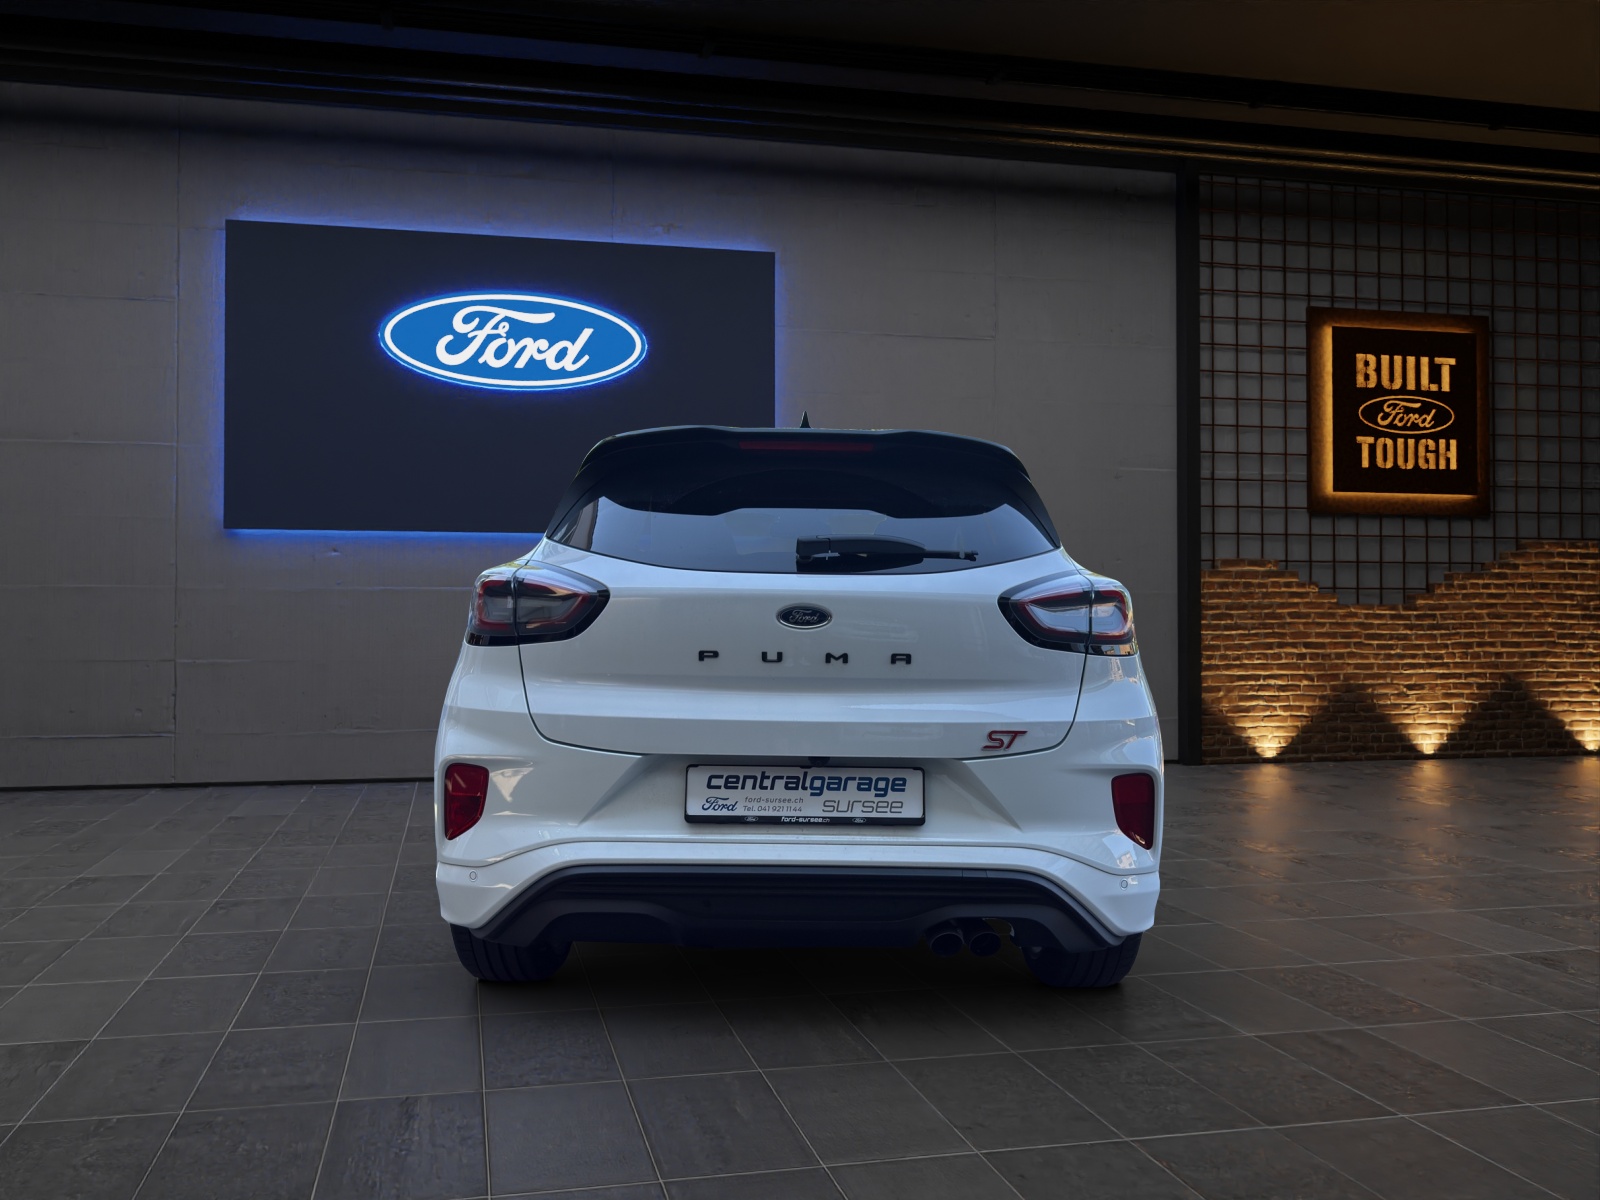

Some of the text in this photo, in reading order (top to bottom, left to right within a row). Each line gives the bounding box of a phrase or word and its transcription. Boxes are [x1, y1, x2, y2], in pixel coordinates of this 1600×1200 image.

[436, 305, 594, 372] Ford
[1355, 353, 1456, 392] BUILT
[1377, 400, 1437, 428] Ford
[1355, 436, 1457, 470] TOUGH
[788, 609, 820, 623] Ford
[698, 650, 912, 665] PUMA
[981, 730, 1028, 751] ST
[706, 770, 907, 797] centralgarage
[701, 796, 739, 812] Ford
[744, 796, 804, 804] ford-sursee.ch
[822, 800, 904, 814] sursee
